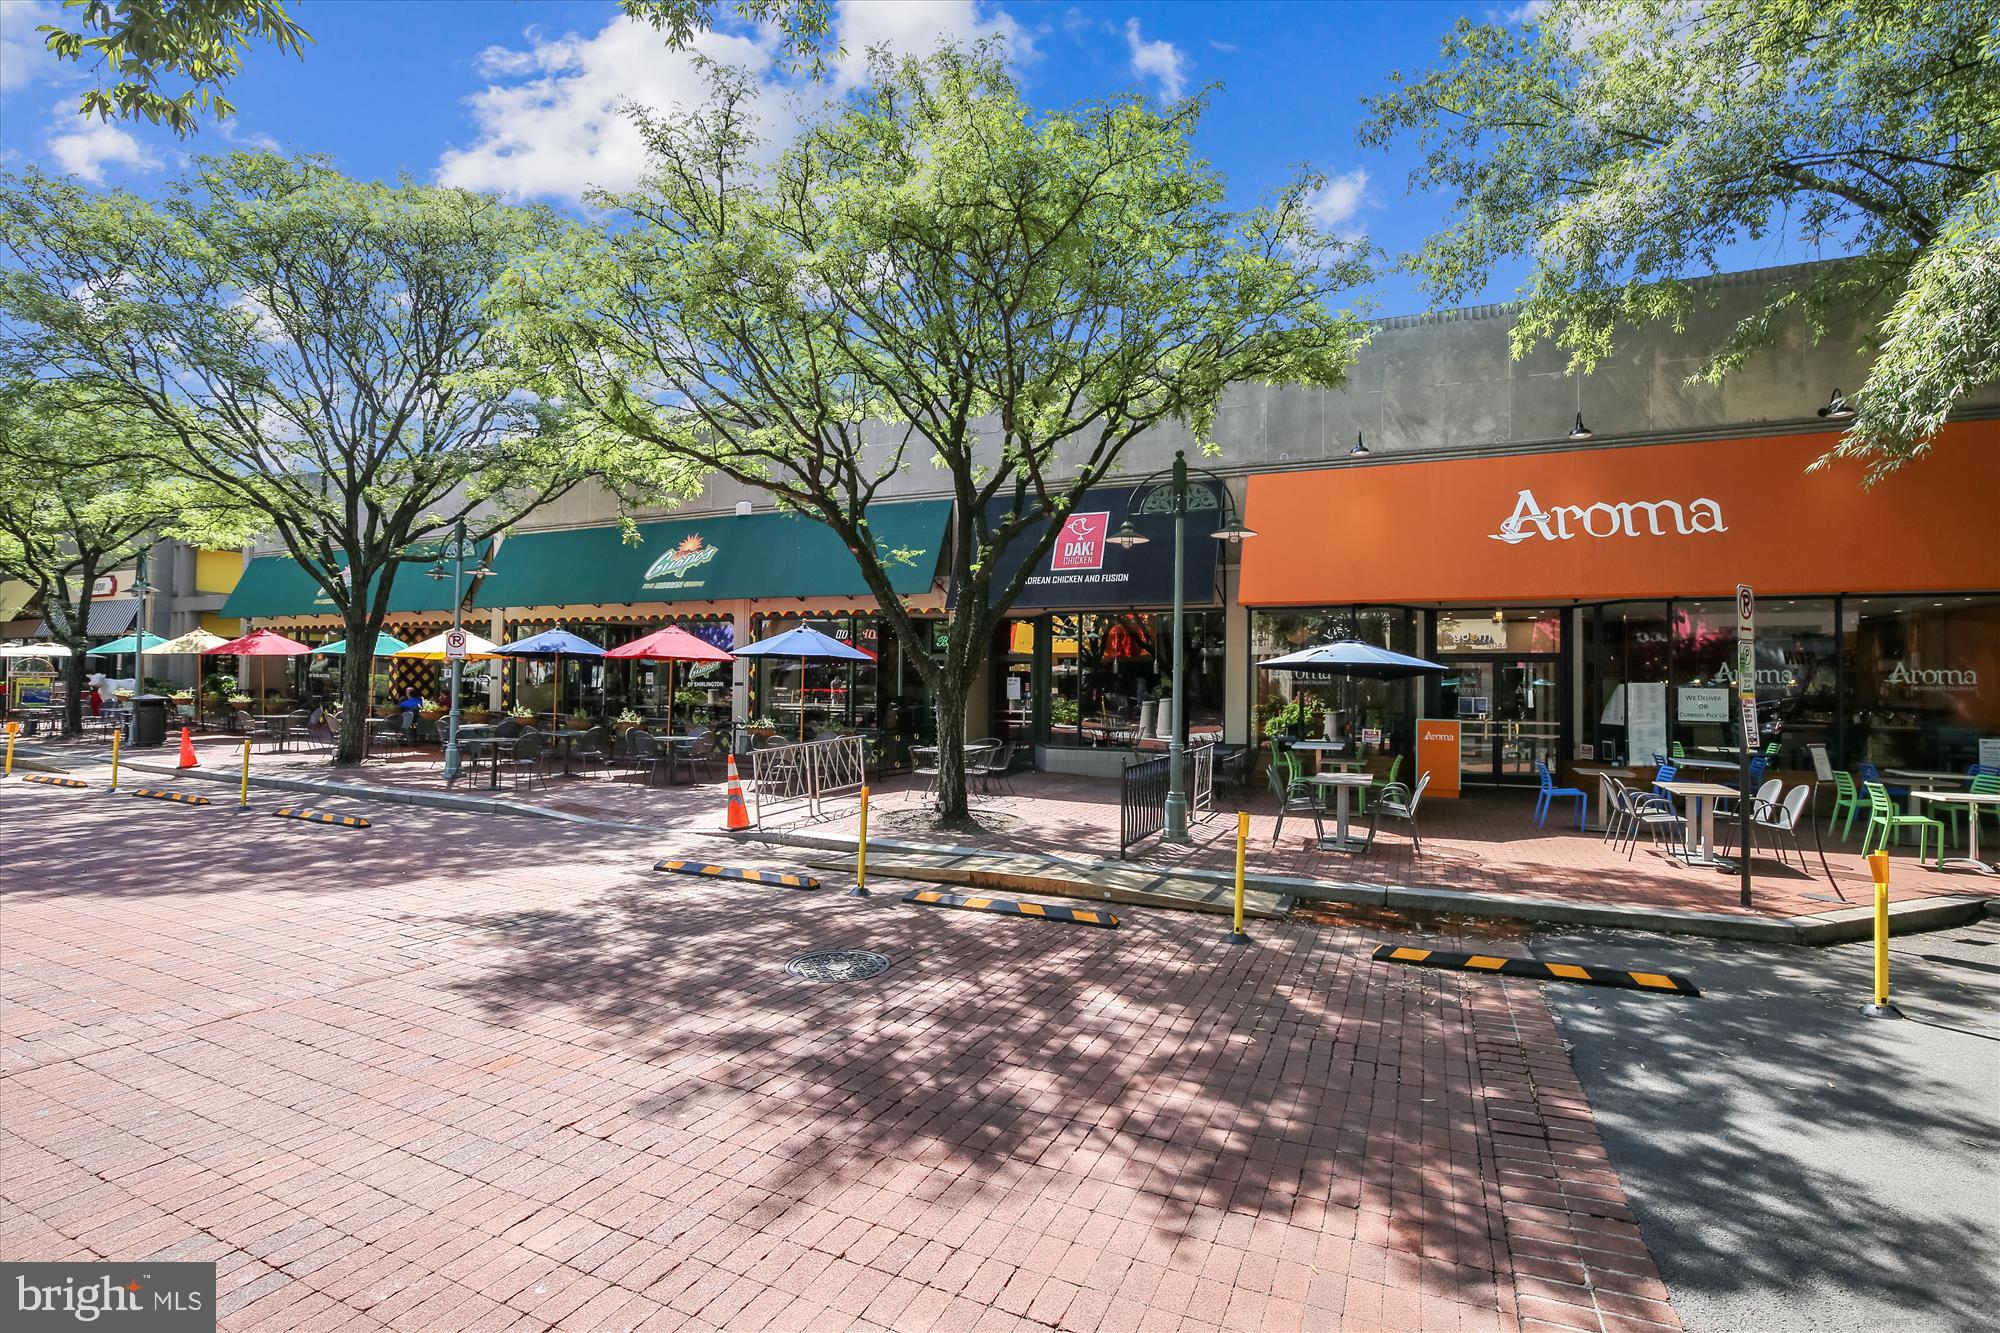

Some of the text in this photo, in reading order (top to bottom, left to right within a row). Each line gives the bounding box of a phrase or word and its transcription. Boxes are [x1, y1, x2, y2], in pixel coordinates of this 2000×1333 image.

[1488, 489, 1728, 544] Aroma
[1064, 541, 1095, 557] DAK!
[1063, 555, 1093, 565] CHICKEN
[1025, 573, 1129, 585] OREAN CHICKEN AND FUSION
[1711, 661, 1794, 683] Arma
[1884, 661, 1977, 685] Aroma
[1424, 731, 1454, 741] Aroma
